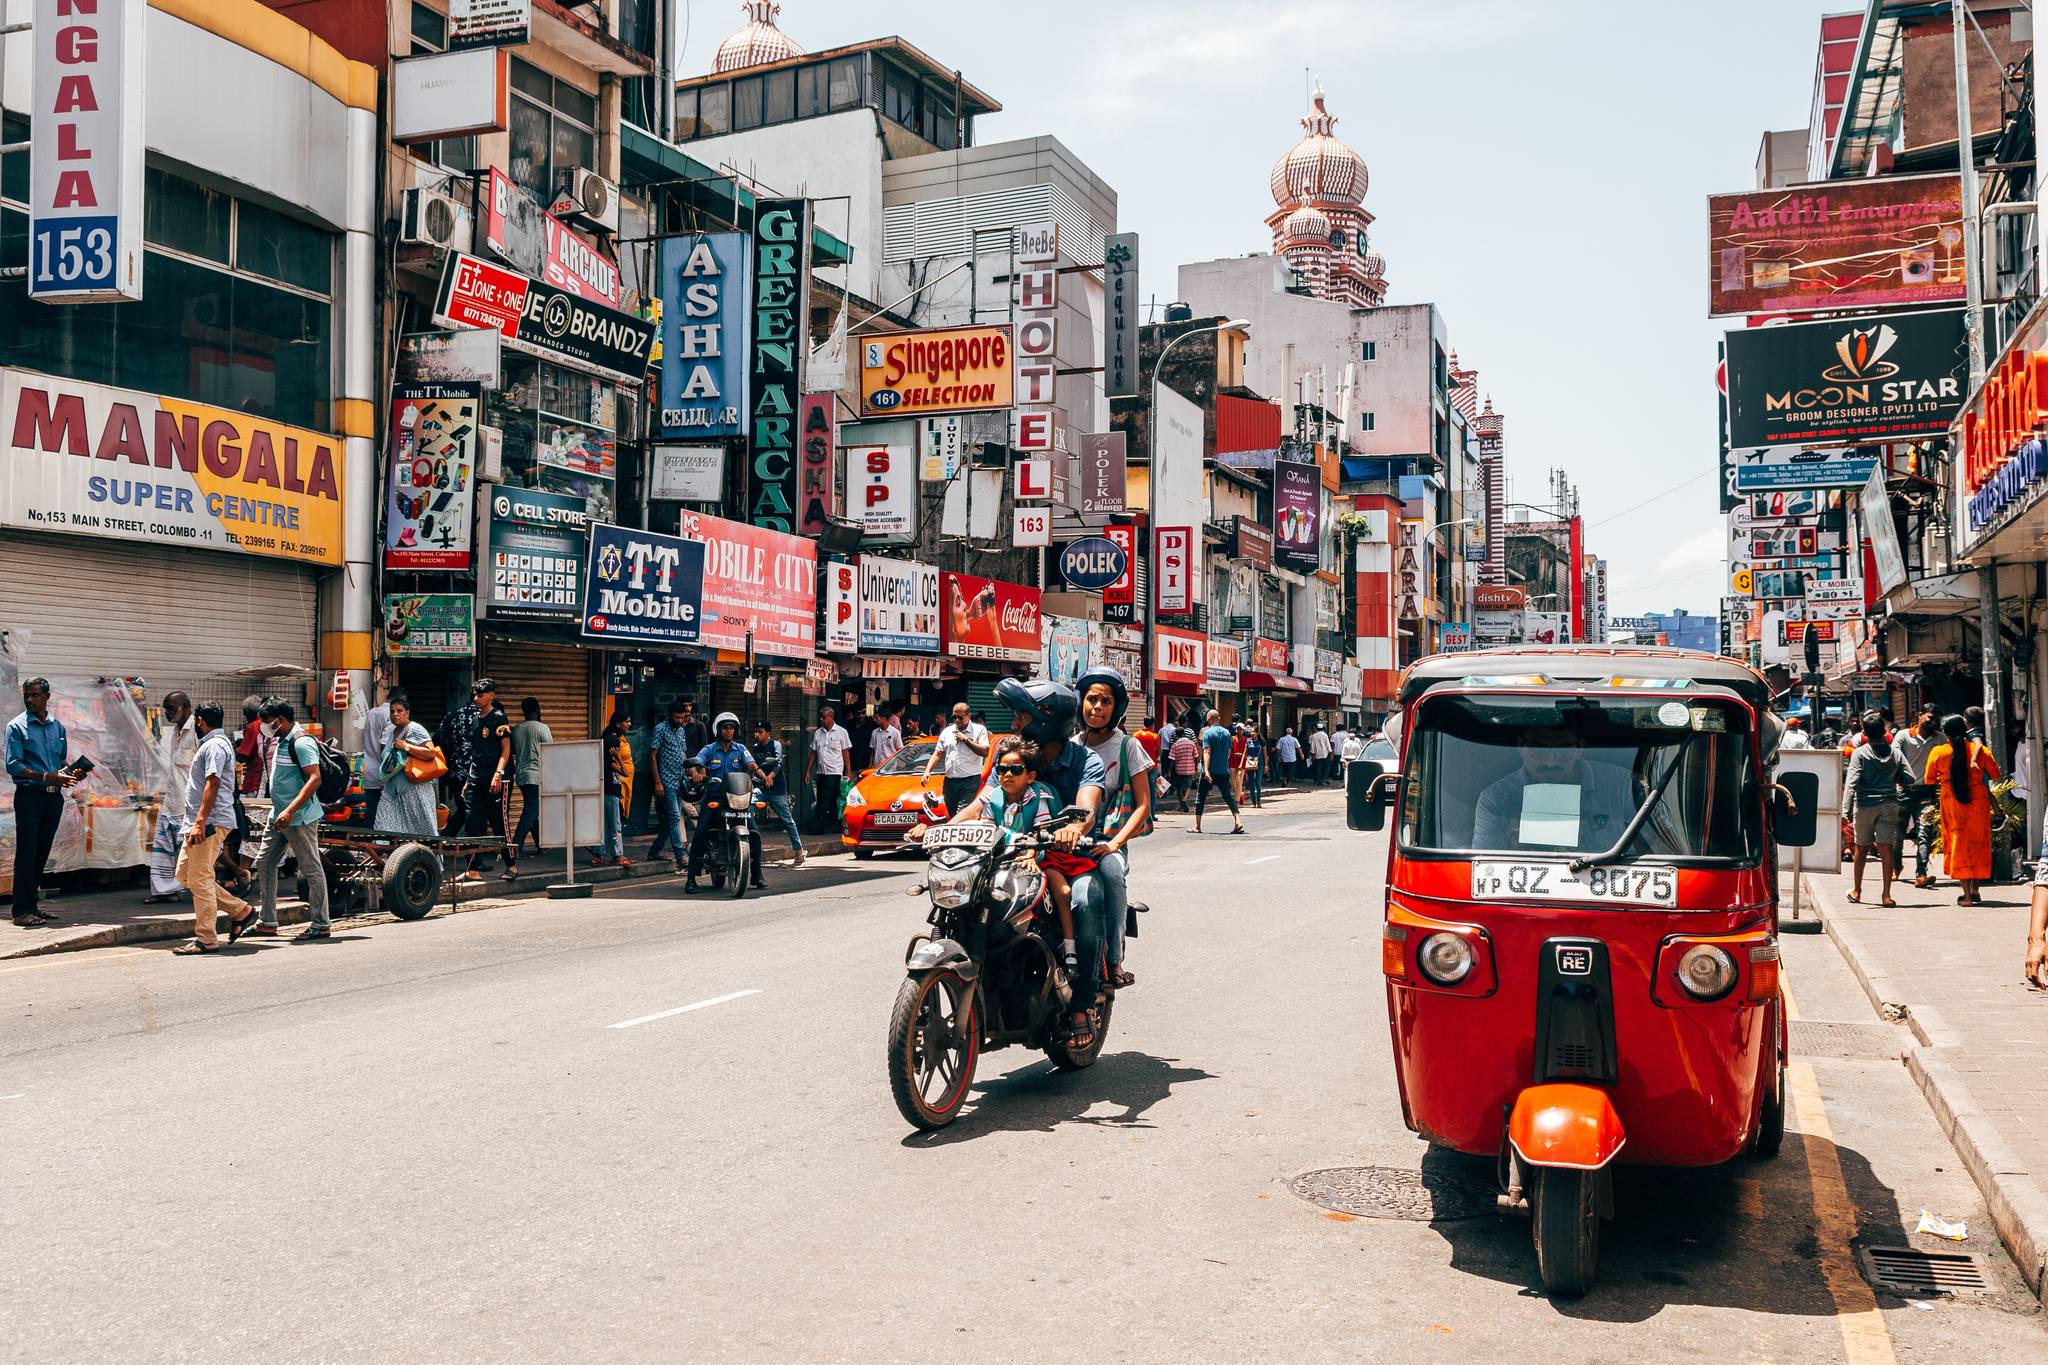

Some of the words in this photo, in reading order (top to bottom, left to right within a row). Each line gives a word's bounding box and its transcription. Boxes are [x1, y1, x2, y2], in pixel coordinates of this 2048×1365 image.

[551, 200, 572, 214] 155
[1730, 196, 1830, 230] Aadil
[37, 227, 112, 282] 153
[1021, 231, 1055, 255] BeeBe
[560, 228, 617, 307] ARCADE
[474, 284, 497, 303] ONE
[503, 290, 524, 312] ONE
[758, 210, 797, 374] GREEN
[570, 308, 648, 358] BRANDZ
[681, 242, 721, 399] ASHA
[533, 335, 564, 351] BRANDED
[567, 345, 591, 359] STUDIO
[885, 335, 1005, 387] Singapore
[404, 389, 424, 398] THE
[423, 385, 443, 398] TT
[442, 390, 470, 398] Mobile
[875, 392, 895, 405] 161
[902, 383, 996, 407] SELECTION
[1019, 273, 1053, 496] HOTEL
[1765, 384, 1870, 412] MOON
[1882, 377, 1960, 402] STAR
[1786, 410, 1823, 422] GROOM
[1826, 407, 1879, 419] DESIGNER
[1918, 402, 1937, 412] LTD
[11, 387, 339, 501] MANGALA
[805, 404, 829, 525] ASHA
[1095, 449, 1110, 497] POLEK
[88, 476, 194, 514] SUPER
[206, 493, 300, 530] CENTRE
[513, 502, 546, 520] CELL
[547, 508, 587, 526] STORE
[1101, 497, 1123, 505] FLOOR
[72, 513, 102, 528] MAIN
[104, 517, 147, 534] STREET,
[149, 523, 198, 539] COLOMBO
[225, 532, 242, 544] TEL:
[245, 535, 276, 549] 2399165
[281, 540, 298, 553] FAX:
[684, 515, 700, 533] MC
[1019, 516, 1044, 533] 163
[624, 541, 680, 592] TT
[774, 552, 817, 597] CITY
[1066, 552, 1118, 575] POLEK
[1164, 536, 1183, 588] DSI
[861, 563, 918, 606] Univercell
[922, 572, 937, 608] OG
[1827, 580, 1857, 588] MOBILE
[598, 588, 695, 622] Mobile
[1114, 605, 1130, 617] 167
[1477, 593, 1512, 603] dishtv
[593, 619, 605, 628] 155
[723, 615, 748, 627] SONY
[1731, 610, 1750, 621] 176
[958, 644, 983, 657] BEE
[987, 647, 1010, 659] BEE
[1445, 634, 1467, 645] BEST
[1167, 641, 1197, 668] DSI
[881, 815, 896, 824] CAD
[898, 814, 916, 823] 4262
[1508, 865, 1550, 894] QZ
[1590, 867, 1673, 900] 8075
[1562, 956, 1586, 970] RE
